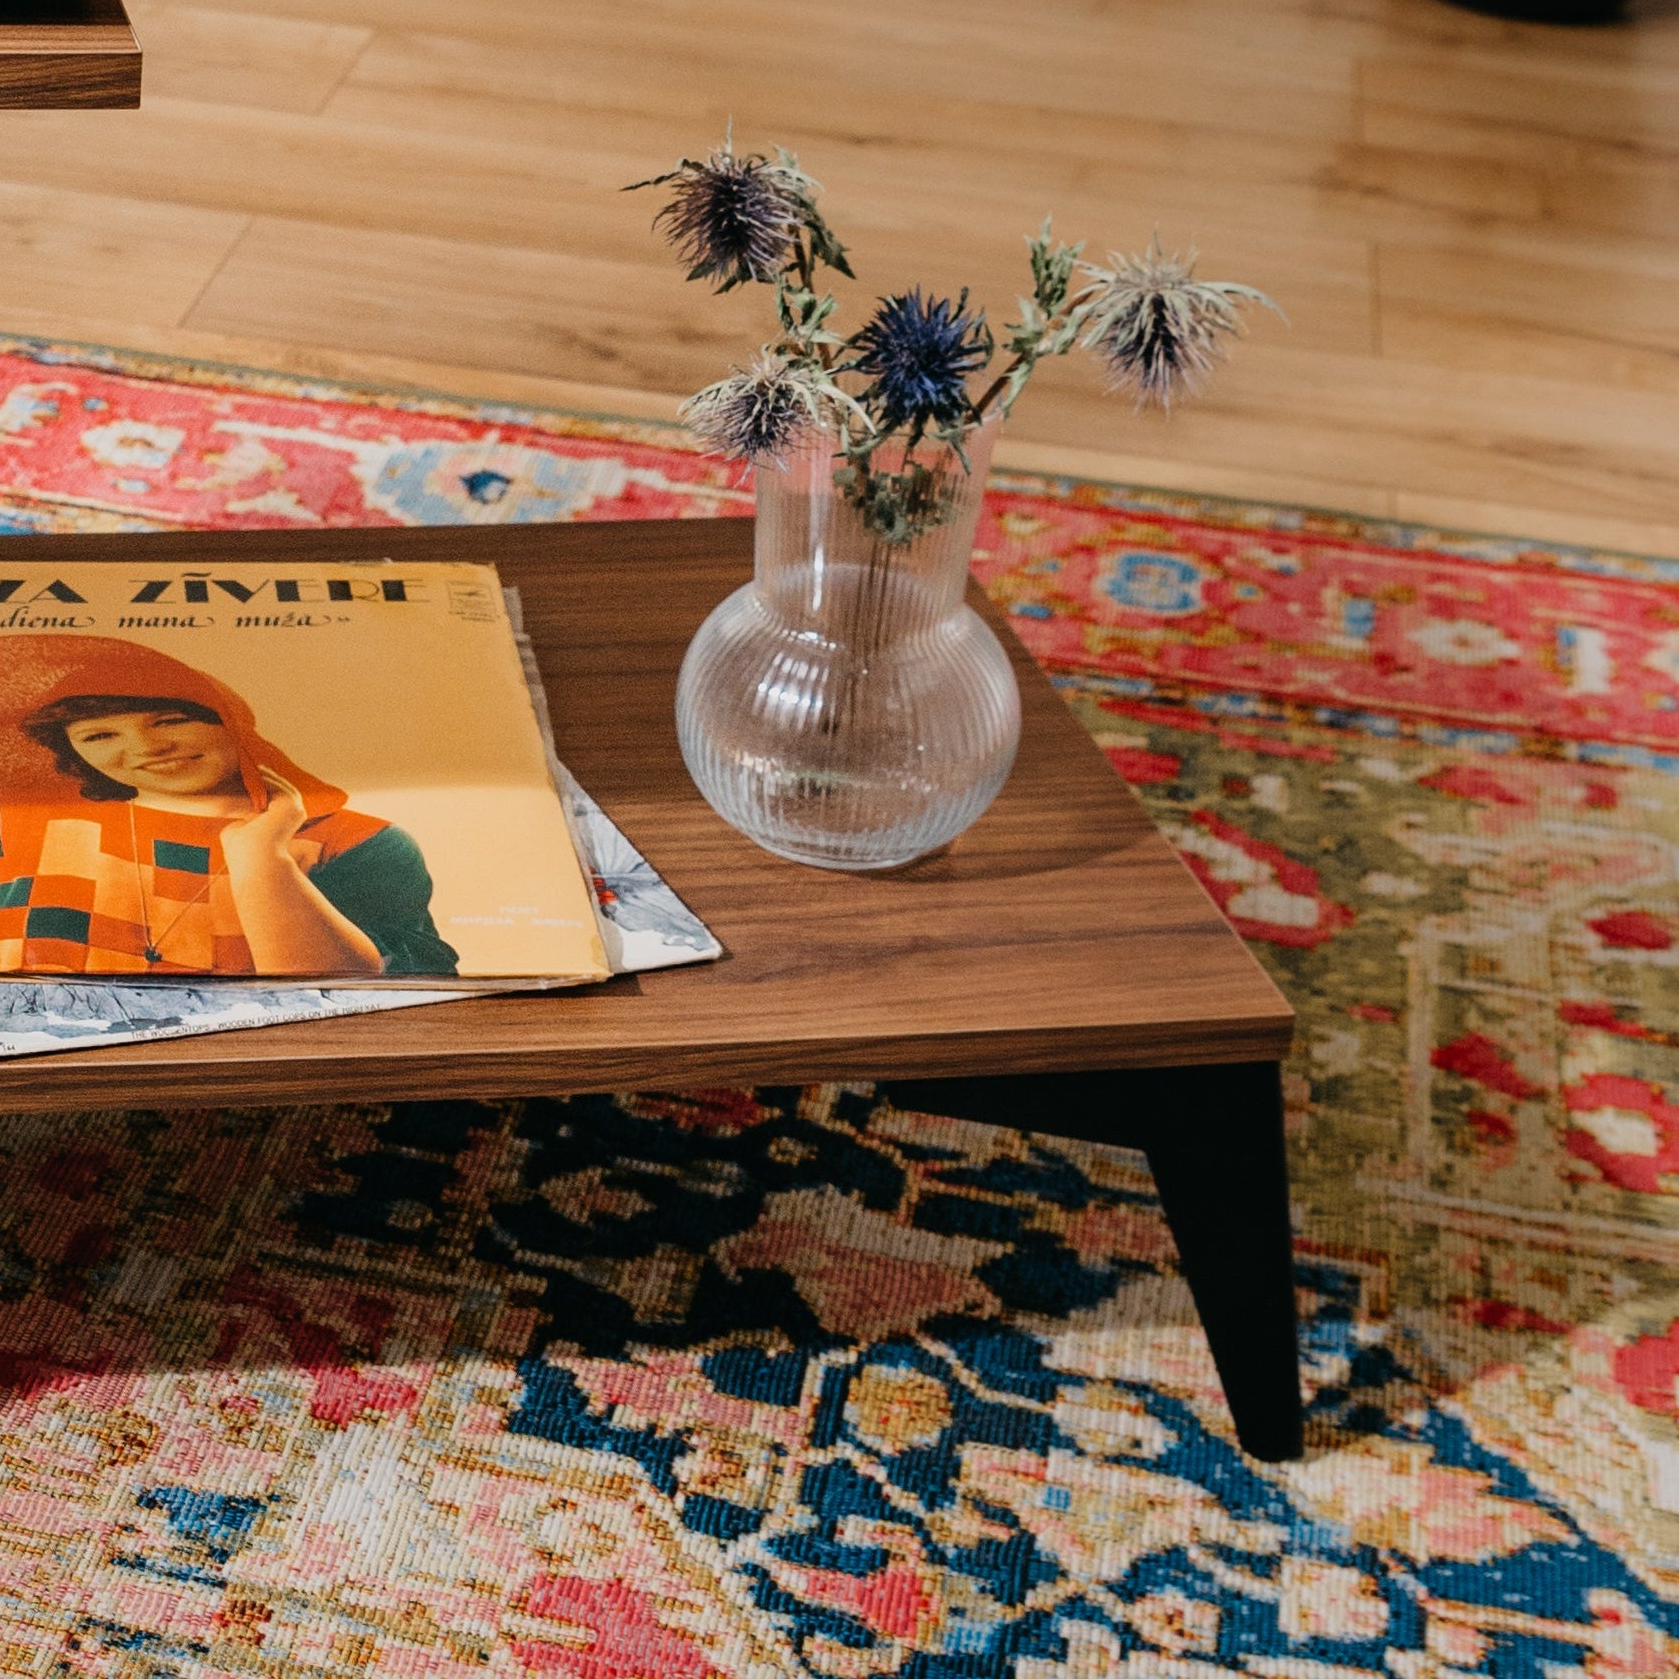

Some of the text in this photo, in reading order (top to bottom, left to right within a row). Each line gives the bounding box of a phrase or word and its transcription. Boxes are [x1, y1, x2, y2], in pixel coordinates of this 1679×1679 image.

[0, 606, 96, 628] diena
[217, 1017, 256, 1030] WOODEN
[257, 1014, 280, 1027] FOOT
